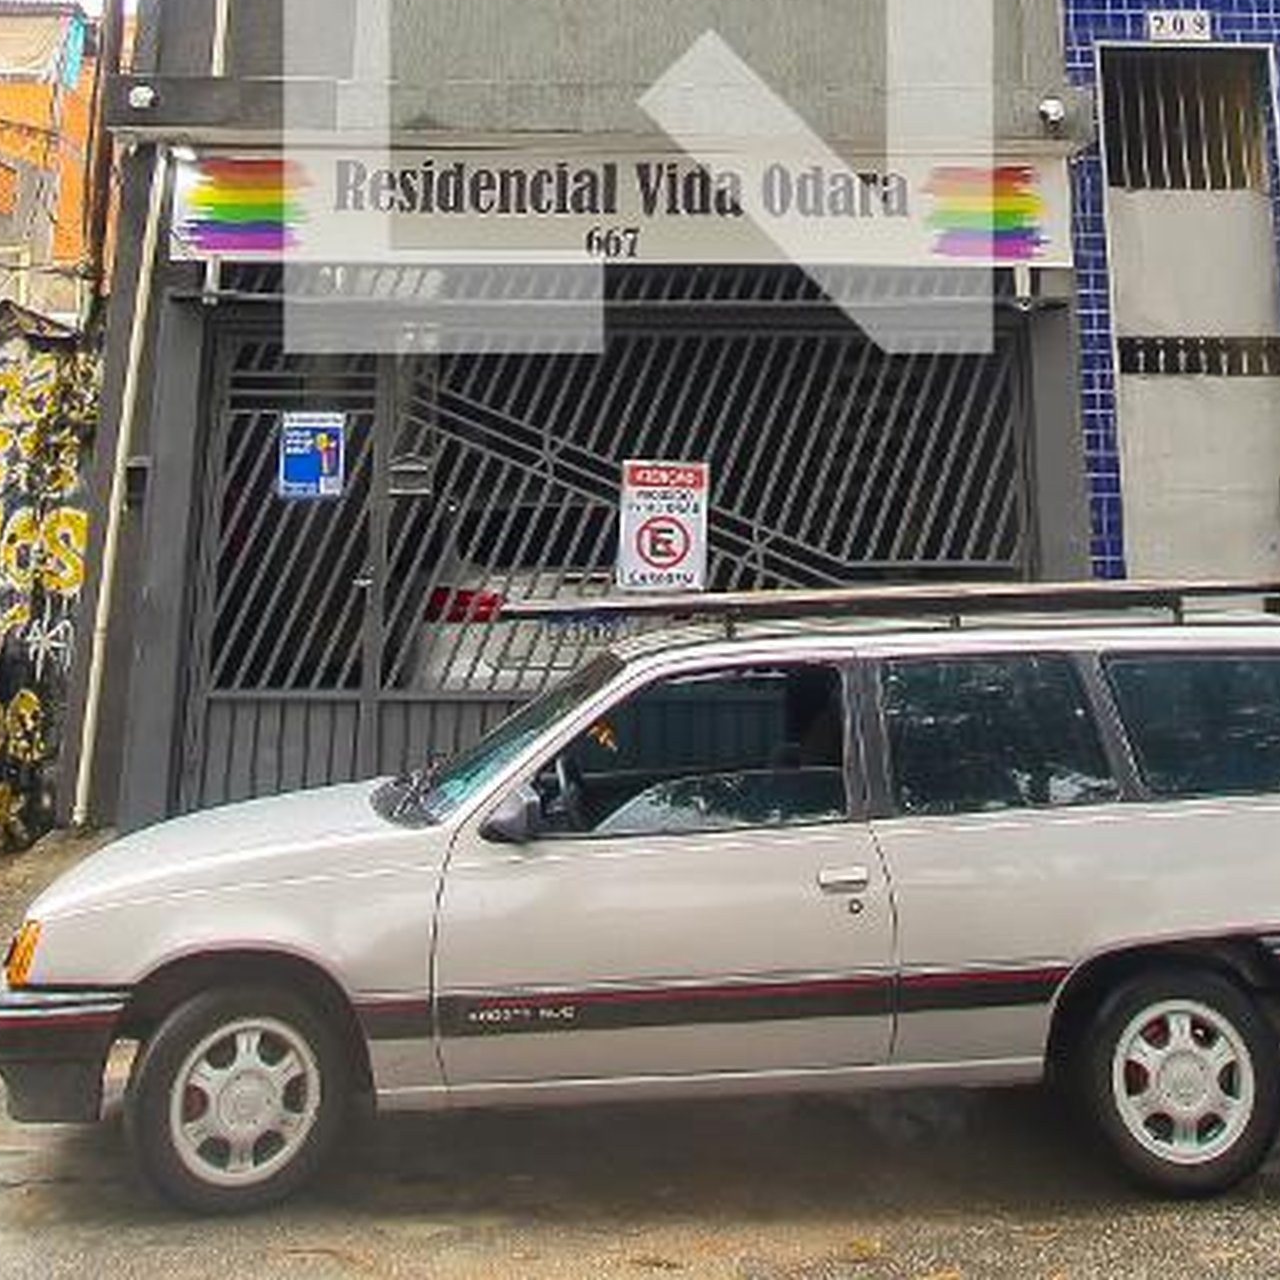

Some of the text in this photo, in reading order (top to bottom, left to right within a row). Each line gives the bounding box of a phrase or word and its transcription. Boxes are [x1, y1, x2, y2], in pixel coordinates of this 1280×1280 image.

[335, 159, 910, 219] Residencial Vida Odara
[586, 227, 640, 257] 667
